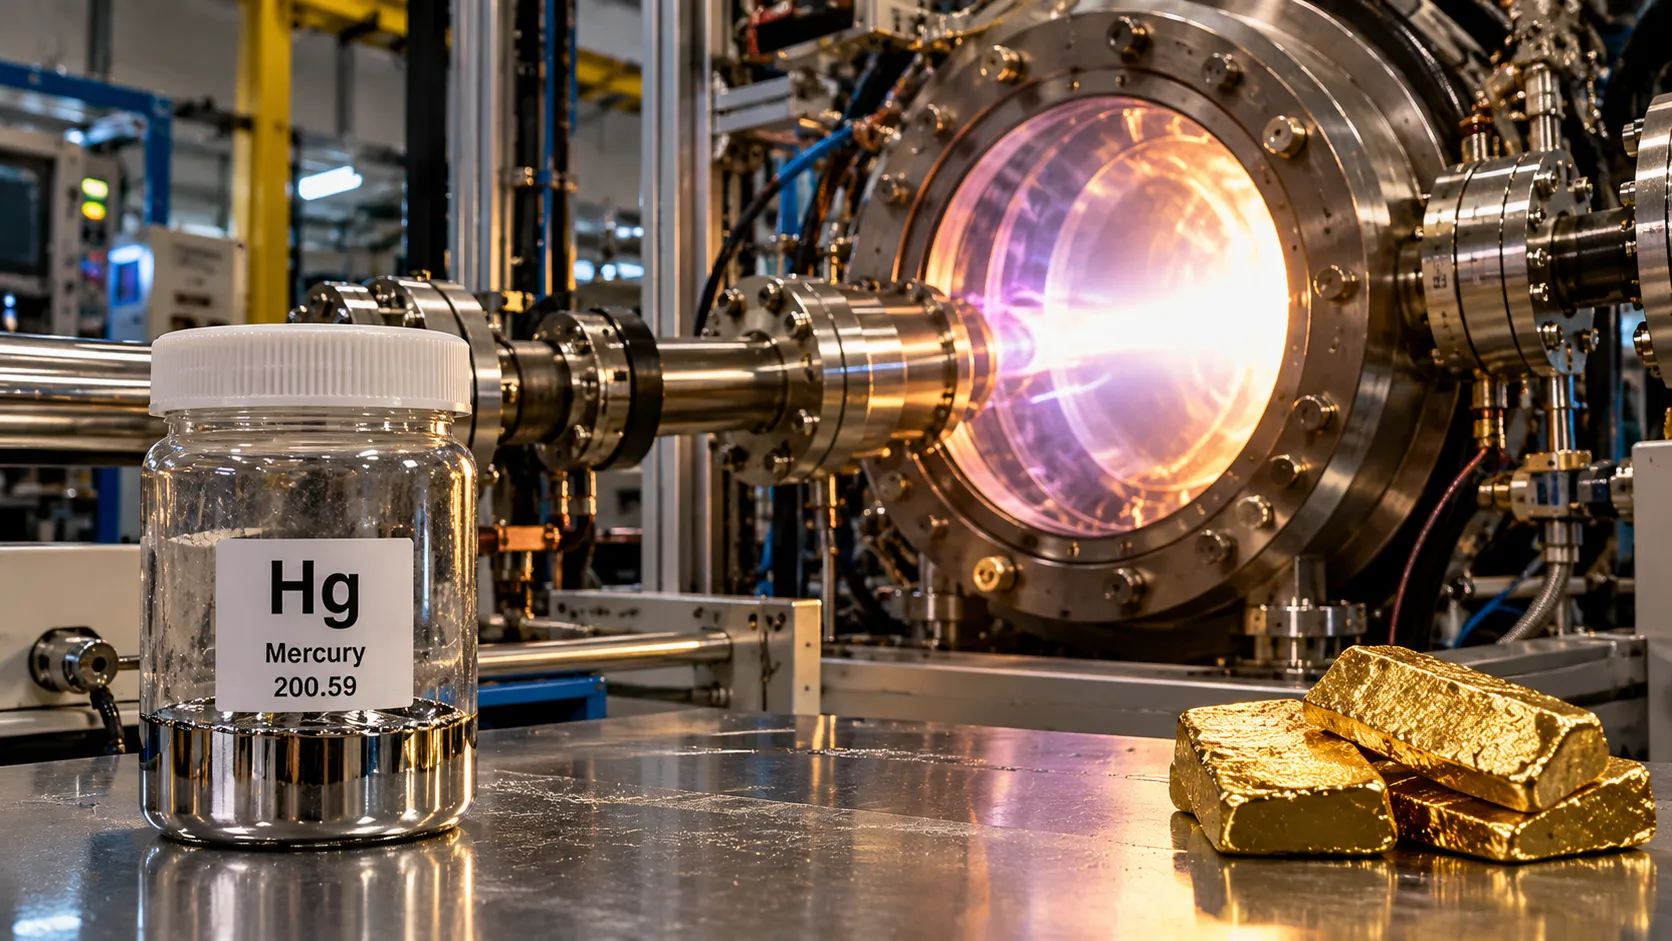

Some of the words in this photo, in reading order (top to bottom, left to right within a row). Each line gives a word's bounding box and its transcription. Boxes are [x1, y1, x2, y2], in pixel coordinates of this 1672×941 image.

[271, 560, 359, 630] Hg
[265, 642, 366, 668] Mercury
[274, 675, 357, 698] 200.59
